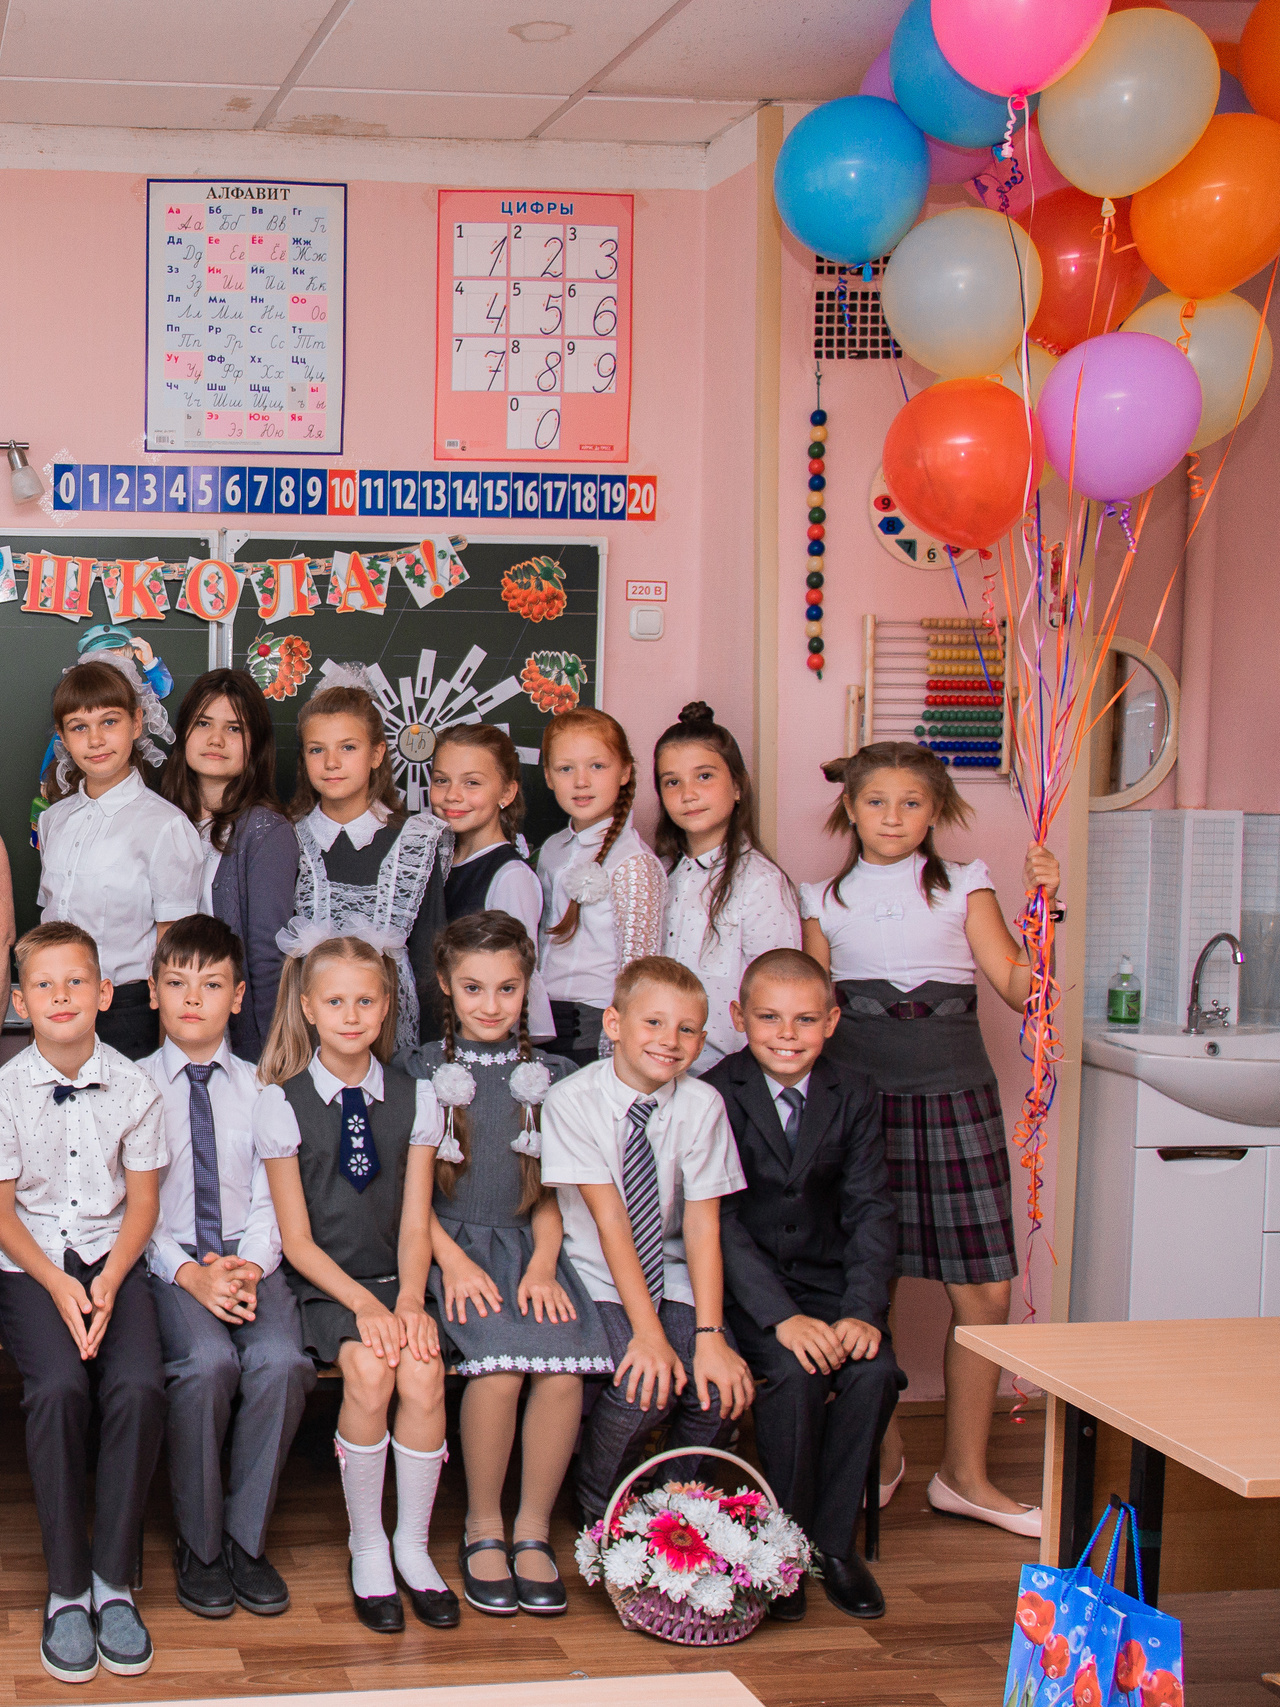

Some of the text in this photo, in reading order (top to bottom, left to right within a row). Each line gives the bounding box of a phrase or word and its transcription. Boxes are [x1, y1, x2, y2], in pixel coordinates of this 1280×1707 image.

[207, 187, 291, 200] АЛФАВИТ
[209, 206, 221, 214] Бб
[501, 202, 573, 215] ЦИФРЫ
[167, 237, 182, 245] Дд
[252, 235, 263, 244] Ёё
[456, 225, 618, 279] 1 1 2 2 3 3
[251, 266, 264, 274] Йй
[293, 267, 304, 275] Кк
[292, 296, 306, 304] Оо
[455, 282, 617, 336] 4 4 5 5 6 6
[209, 326, 221, 334] Рр
[166, 354, 179, 363] Уу
[208, 355, 225, 364] Фф
[292, 356, 306, 364] Цц
[455, 339, 616, 393] 7 7 8 8 9 9
[250, 384, 270, 392] Щщ
[249, 413, 269, 421] Юю
[510, 398, 560, 449] 0 0
[60, 472, 655, 514] 0 1 2 3 4 5 6 7 8 9 10 11 12 13 14 15 16 17 18 19 20
[882, 498, 891, 509] 9
[886, 520, 895, 532] 8
[904, 541, 912, 553] 7
[927, 548, 936, 562] 6
[20, 539, 446, 620] ШКОЛА!
[632, 586, 662, 595] 220 В
